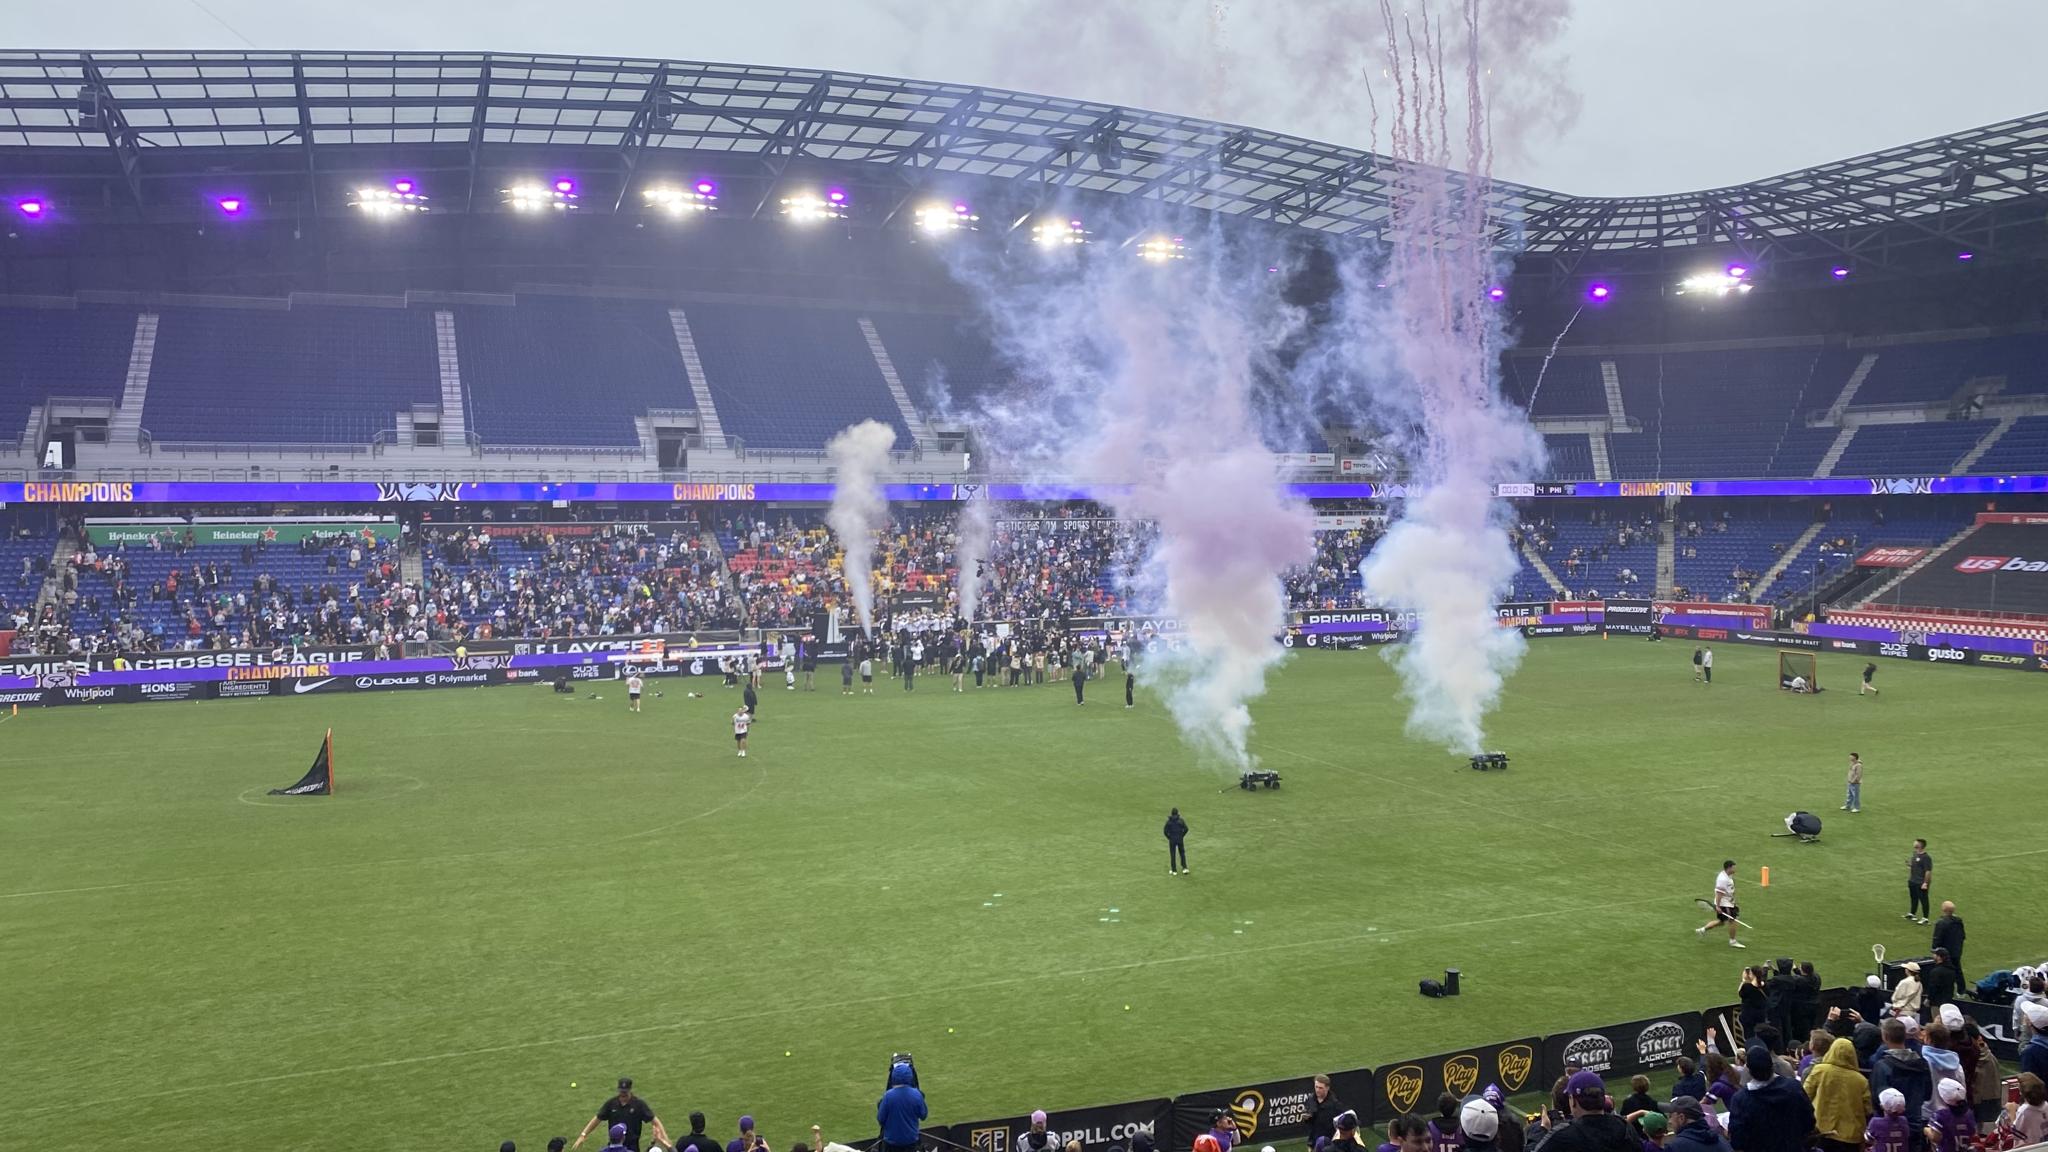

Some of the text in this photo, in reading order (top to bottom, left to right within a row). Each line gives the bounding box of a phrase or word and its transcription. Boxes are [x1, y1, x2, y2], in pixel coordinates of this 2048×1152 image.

[24, 482, 134, 501] CHAMPIONS
[673, 483, 756, 500] CHAMPIONS
[1620, 482, 1693, 496] CHAMPIONS
[212, 530, 259, 540] Heineken
[1959, 558, 2000, 570] us
[1309, 614, 1382, 625] PREMIER
[1573, 624, 1597, 634] Whirlpool
[1698, 628, 1728, 638] ESPN
[1371, 632, 1398, 642] Whirlpool
[1841, 641, 1857, 649] bank
[1880, 643, 1909, 651] DUDE
[1928, 648, 1965, 661] gusto
[518, 669, 539, 677] bank
[572, 665, 599, 674] DUDE
[373, 676, 420, 685] LEXUS
[439, 674, 487, 684] Polymarket
[223, 683, 266, 691] INGREDIENTS
[65, 687, 115, 702] Whirlpool
[1640, 1035, 1681, 1055] STREET
[1639, 1048, 1683, 1064] LACROSSE
[1500, 1052, 1530, 1082] Play
[1446, 1062, 1478, 1093] Play
[1390, 1074, 1422, 1105] Play
